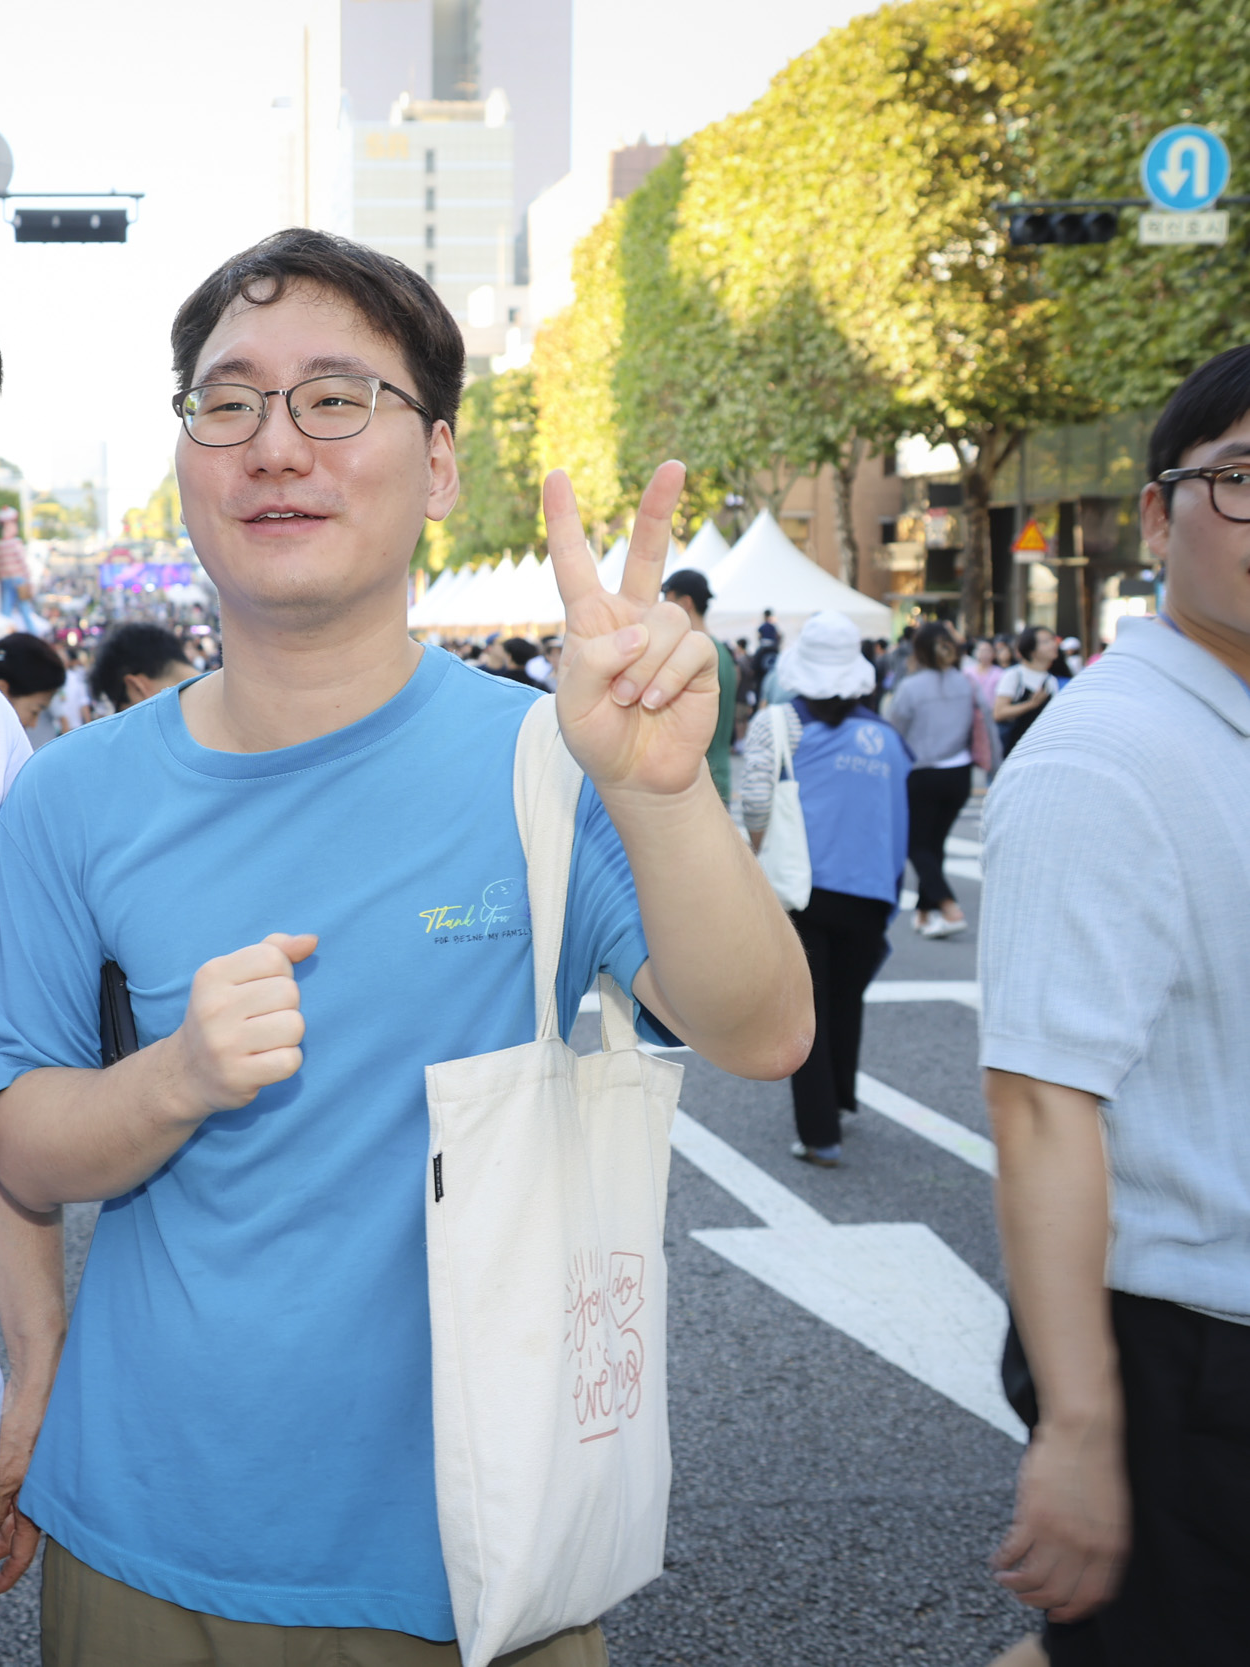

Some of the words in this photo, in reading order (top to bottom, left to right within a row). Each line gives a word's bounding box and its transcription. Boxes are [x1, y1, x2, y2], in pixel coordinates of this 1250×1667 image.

[418, 905, 476, 934] Thank
[480, 904, 511, 936] You
[434, 936, 449, 945] FOR
[453, 935, 484, 944] BEING
[488, 933, 499, 941] MY
